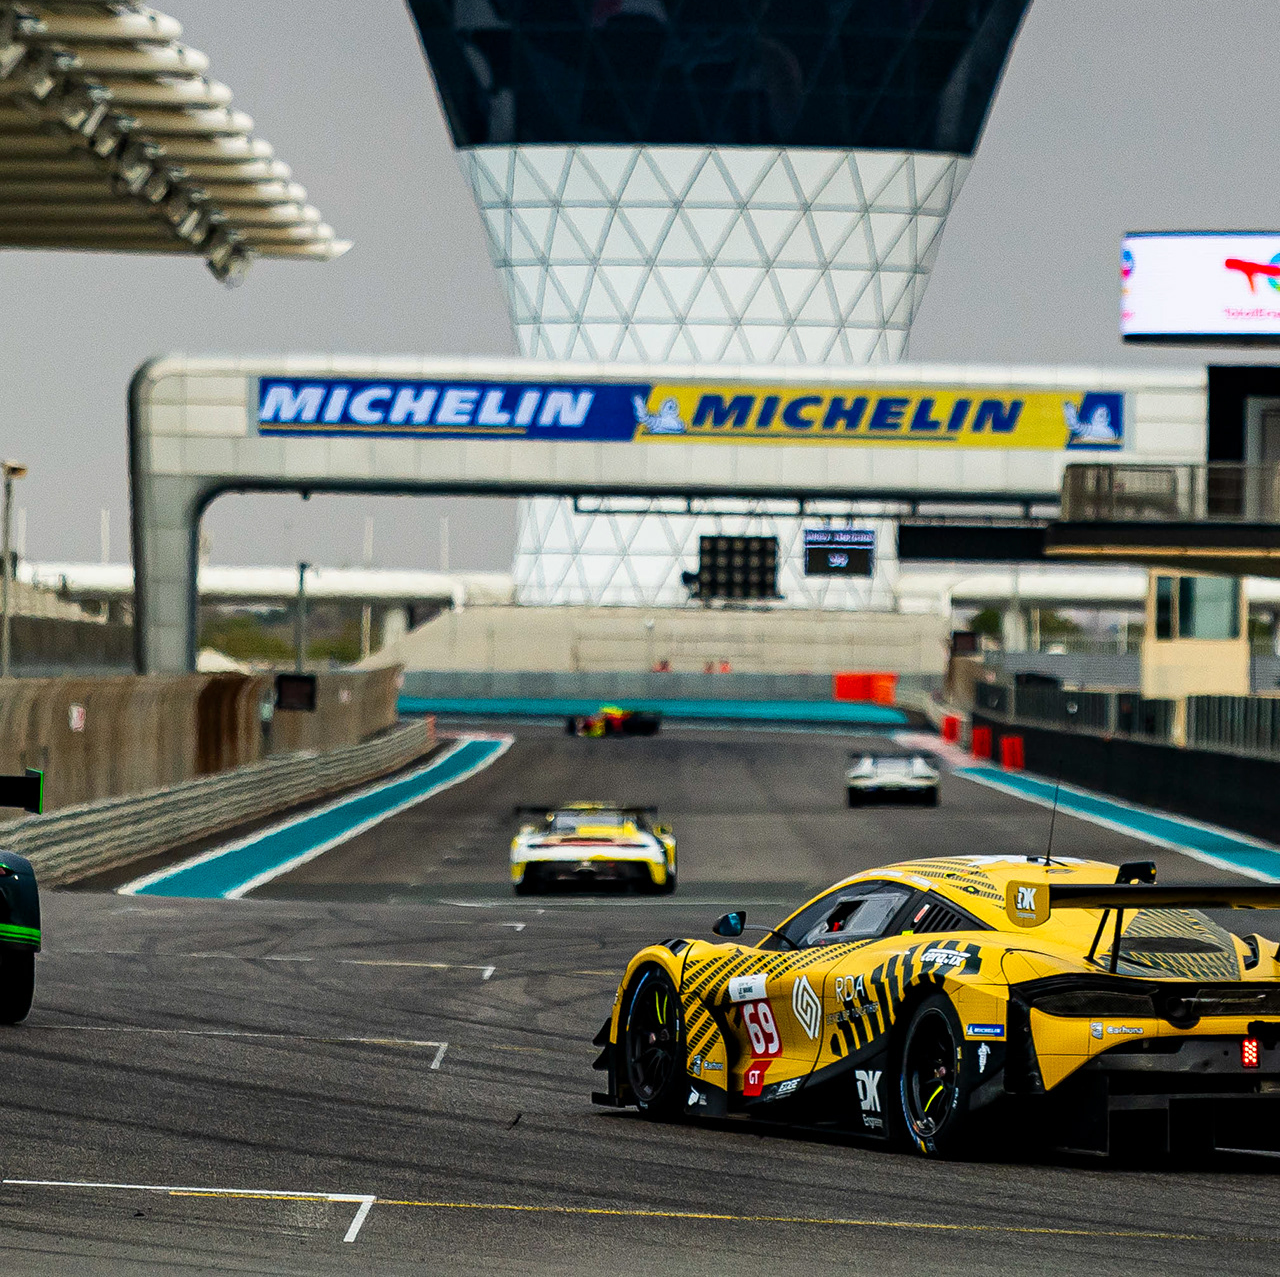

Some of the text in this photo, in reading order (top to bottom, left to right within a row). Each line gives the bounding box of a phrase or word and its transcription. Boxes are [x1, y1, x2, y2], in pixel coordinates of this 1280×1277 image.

[260, 386, 594, 428] MICHELIN
[691, 394, 1024, 435] MICHELIN
[835, 975, 866, 1003] RDA
[742, 1001, 781, 1055] 69
[748, 1070, 761, 1086] GT
